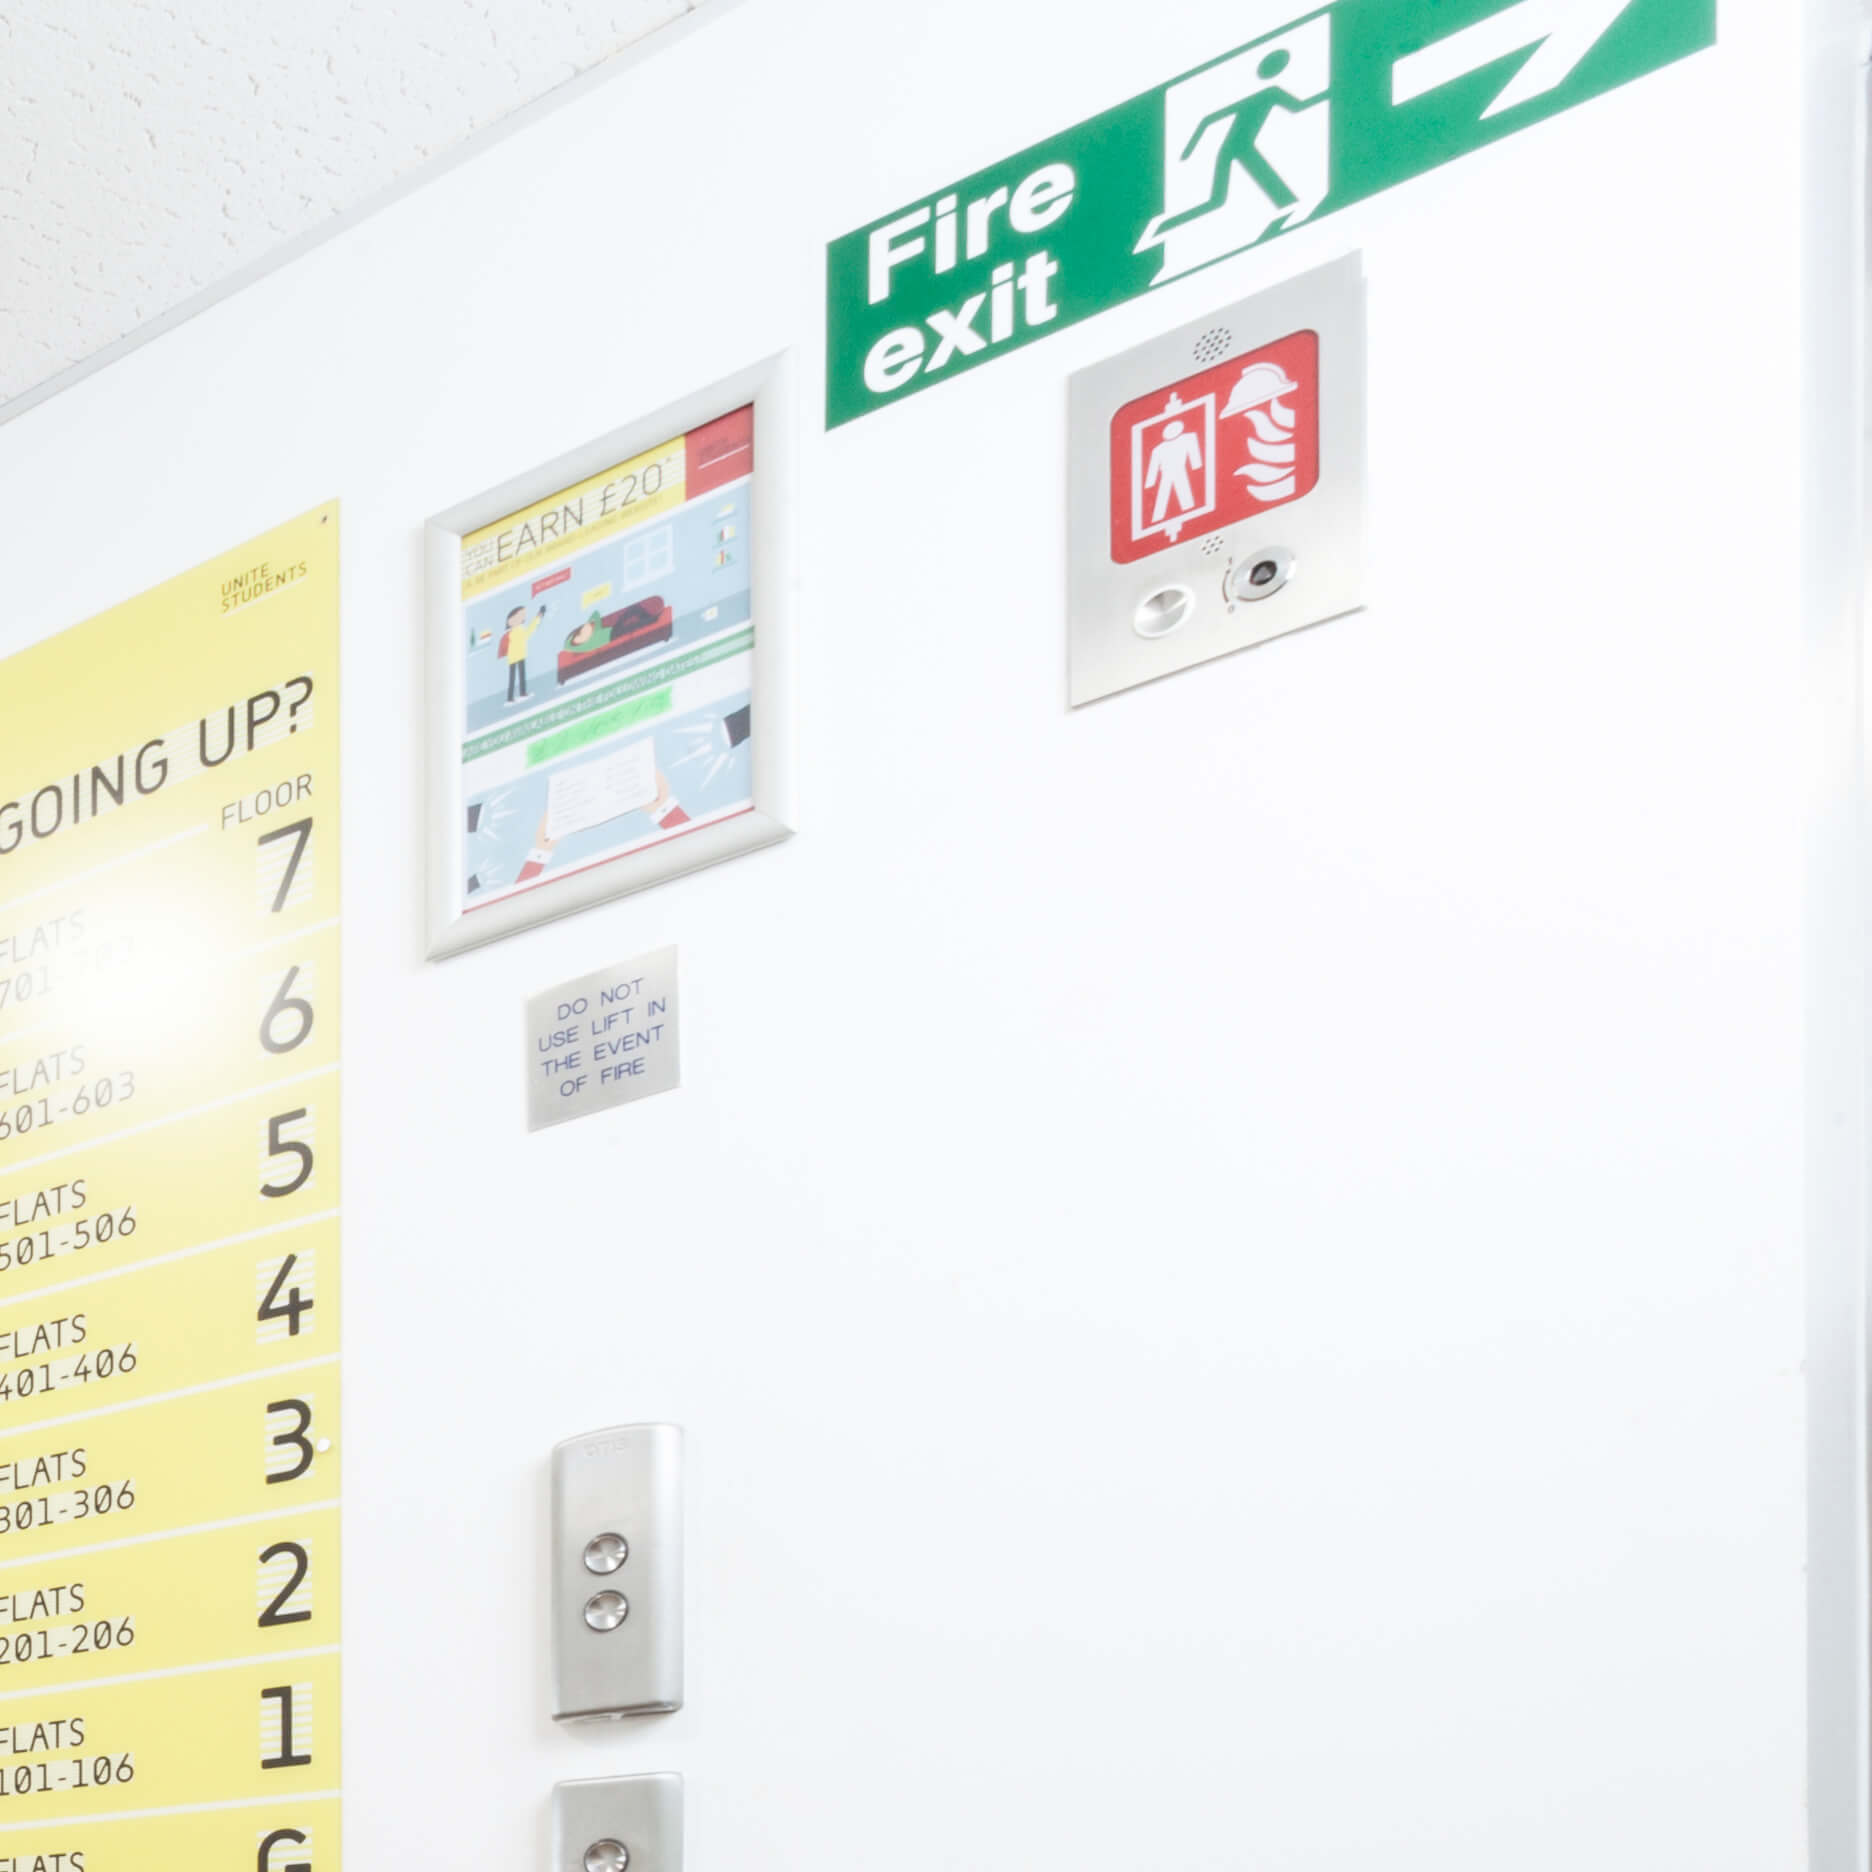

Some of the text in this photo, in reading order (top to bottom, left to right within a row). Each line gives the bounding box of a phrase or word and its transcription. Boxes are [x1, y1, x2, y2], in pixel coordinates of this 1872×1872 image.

[867, 161, 1077, 306] Fire
[863, 249, 1059, 394] exit
[497, 498, 583, 563] EARN
[221, 563, 271, 598] UNITE
[221, 562, 307, 614] STUDENTS
[199, 676, 314, 767] UP?
[221, 773, 313, 831] FLOOR
[257, 816, 314, 913] 7
[259, 965, 314, 1054] 6
[538, 996, 666, 1052] USE LIFT IN
[557, 977, 644, 1021] DO NOT
[541, 1024, 664, 1076] THE EVENT
[560, 1057, 645, 1097] OF FIRE
[260, 1107, 313, 1198] 5
[256, 1254, 314, 1336] 4
[266, 1398, 313, 1484] 3
[257, 1541, 312, 1628] 2
[261, 1685, 311, 1769] 1
